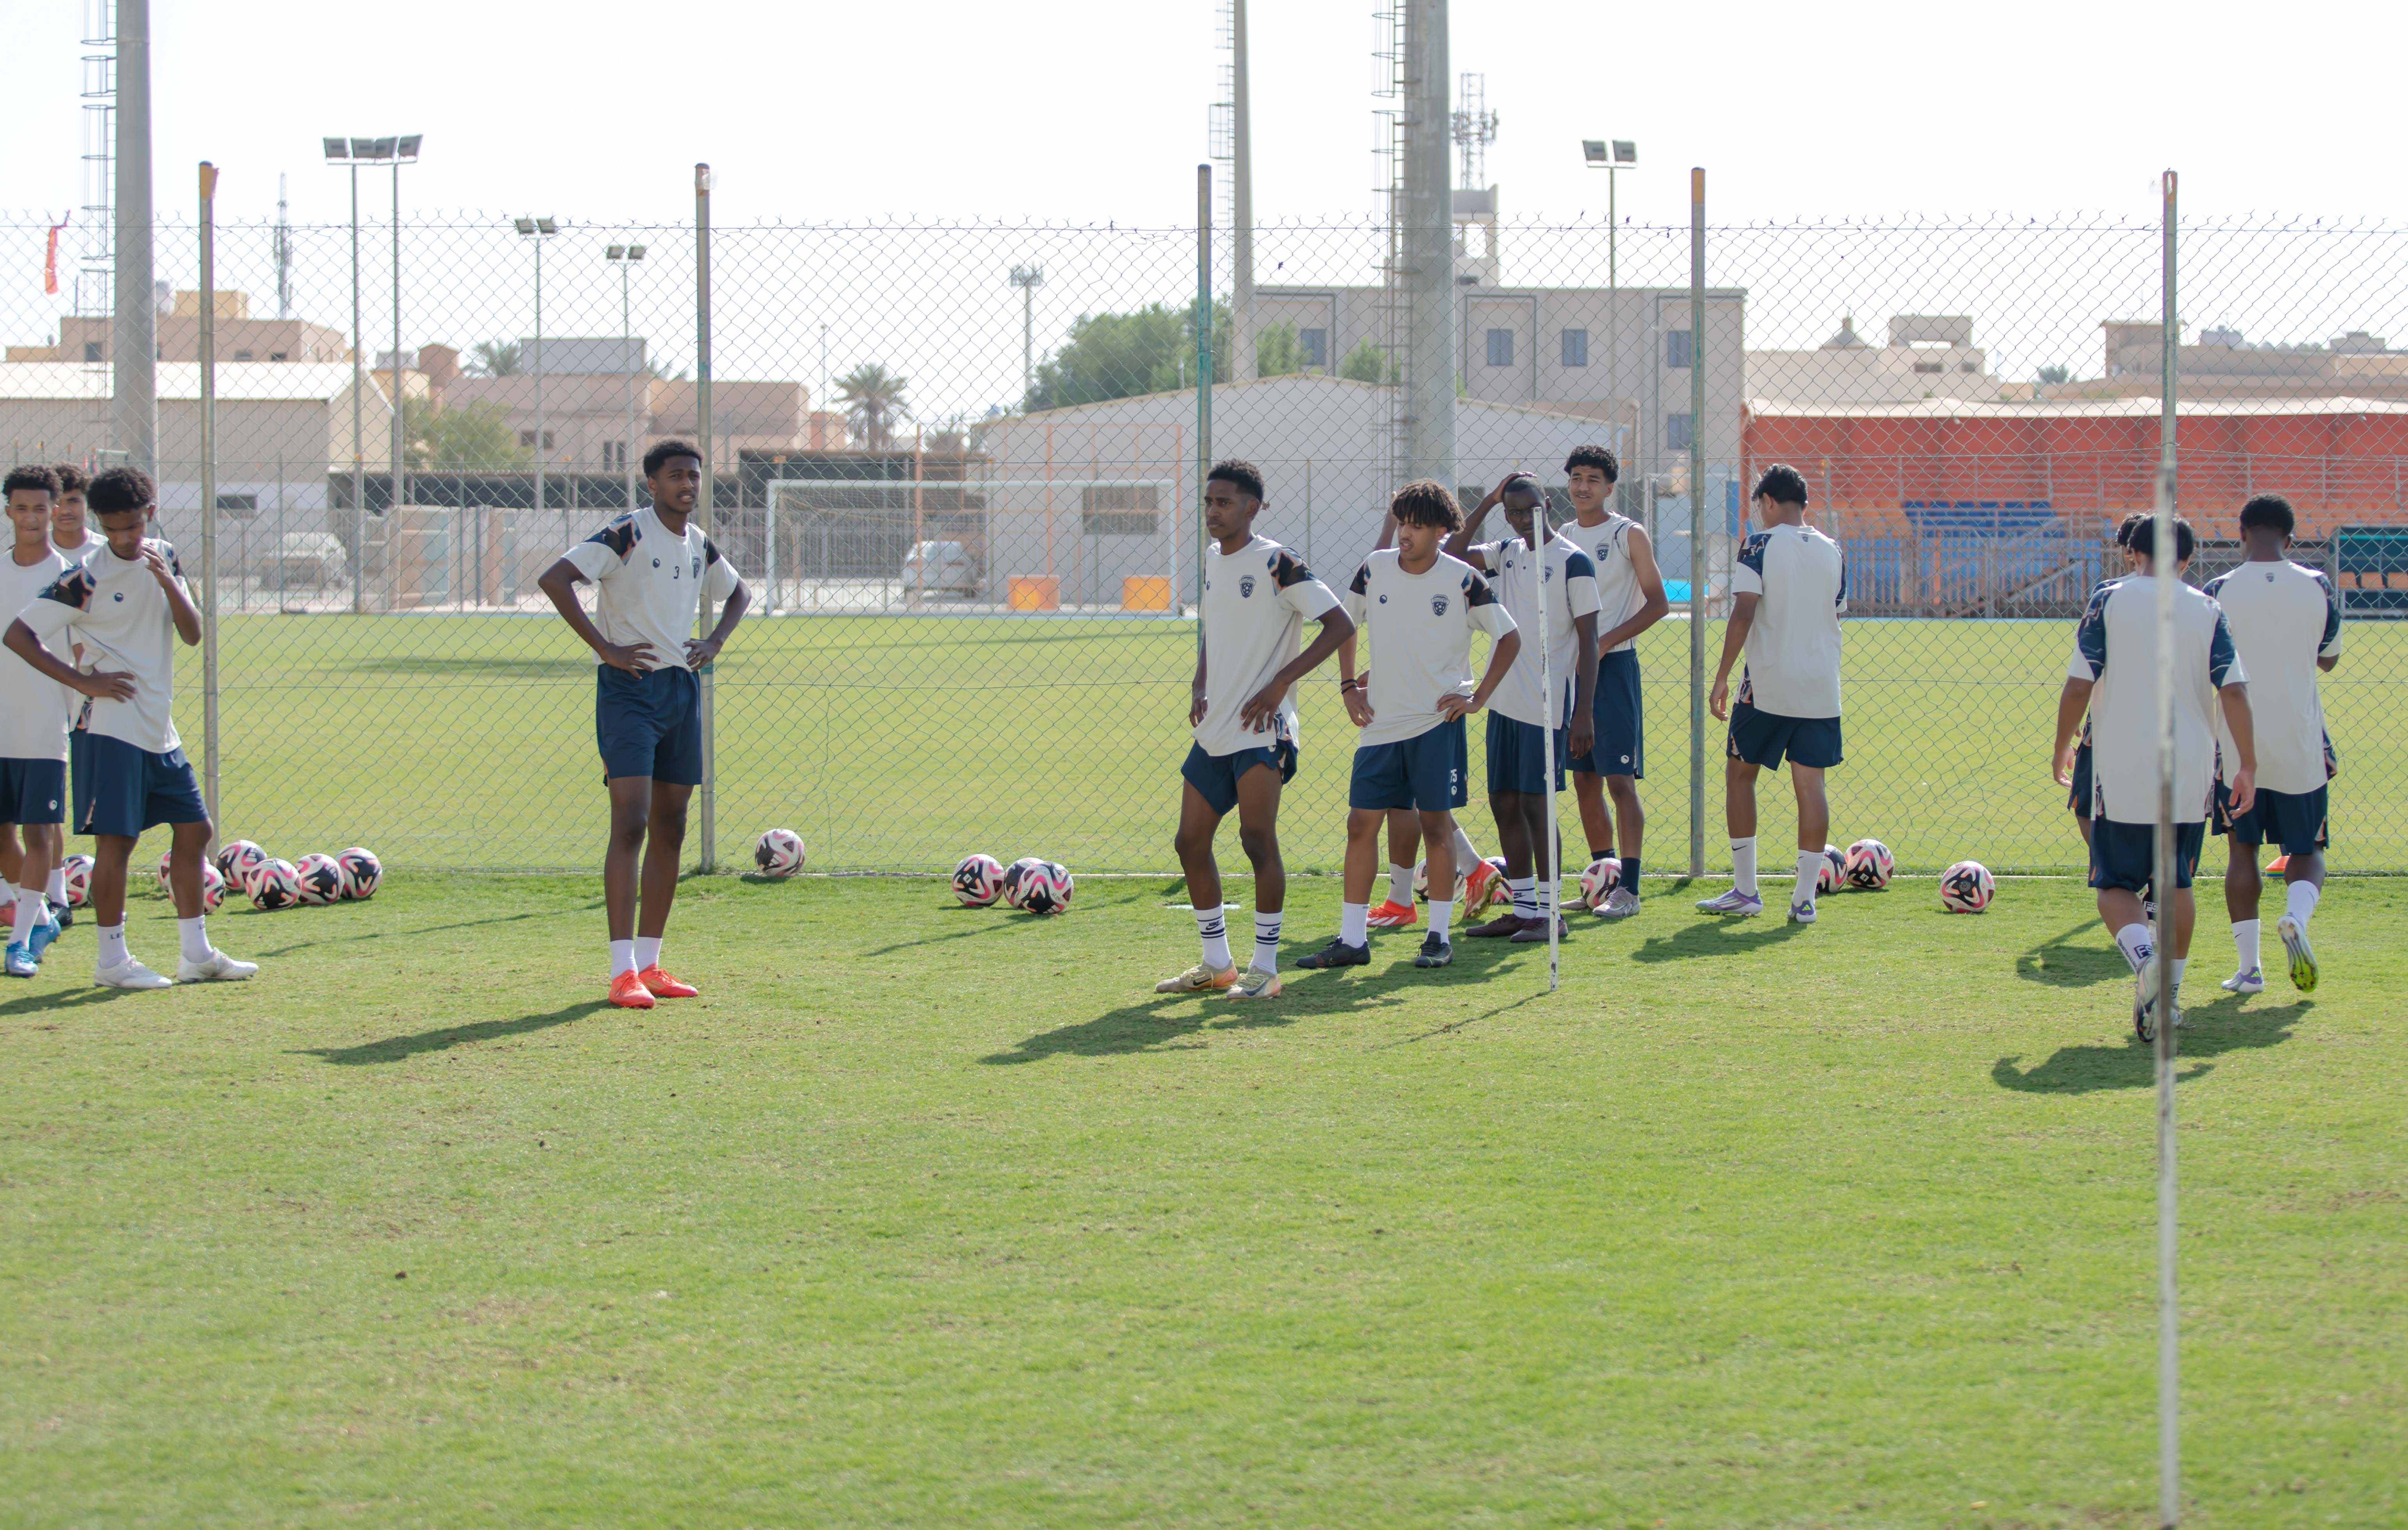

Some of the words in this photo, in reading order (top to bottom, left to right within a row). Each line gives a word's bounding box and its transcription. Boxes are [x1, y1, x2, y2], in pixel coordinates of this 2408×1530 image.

[673, 565, 680, 579] 3
[1450, 769, 1457, 783] 75
[2145, 902, 2158, 912] FS
